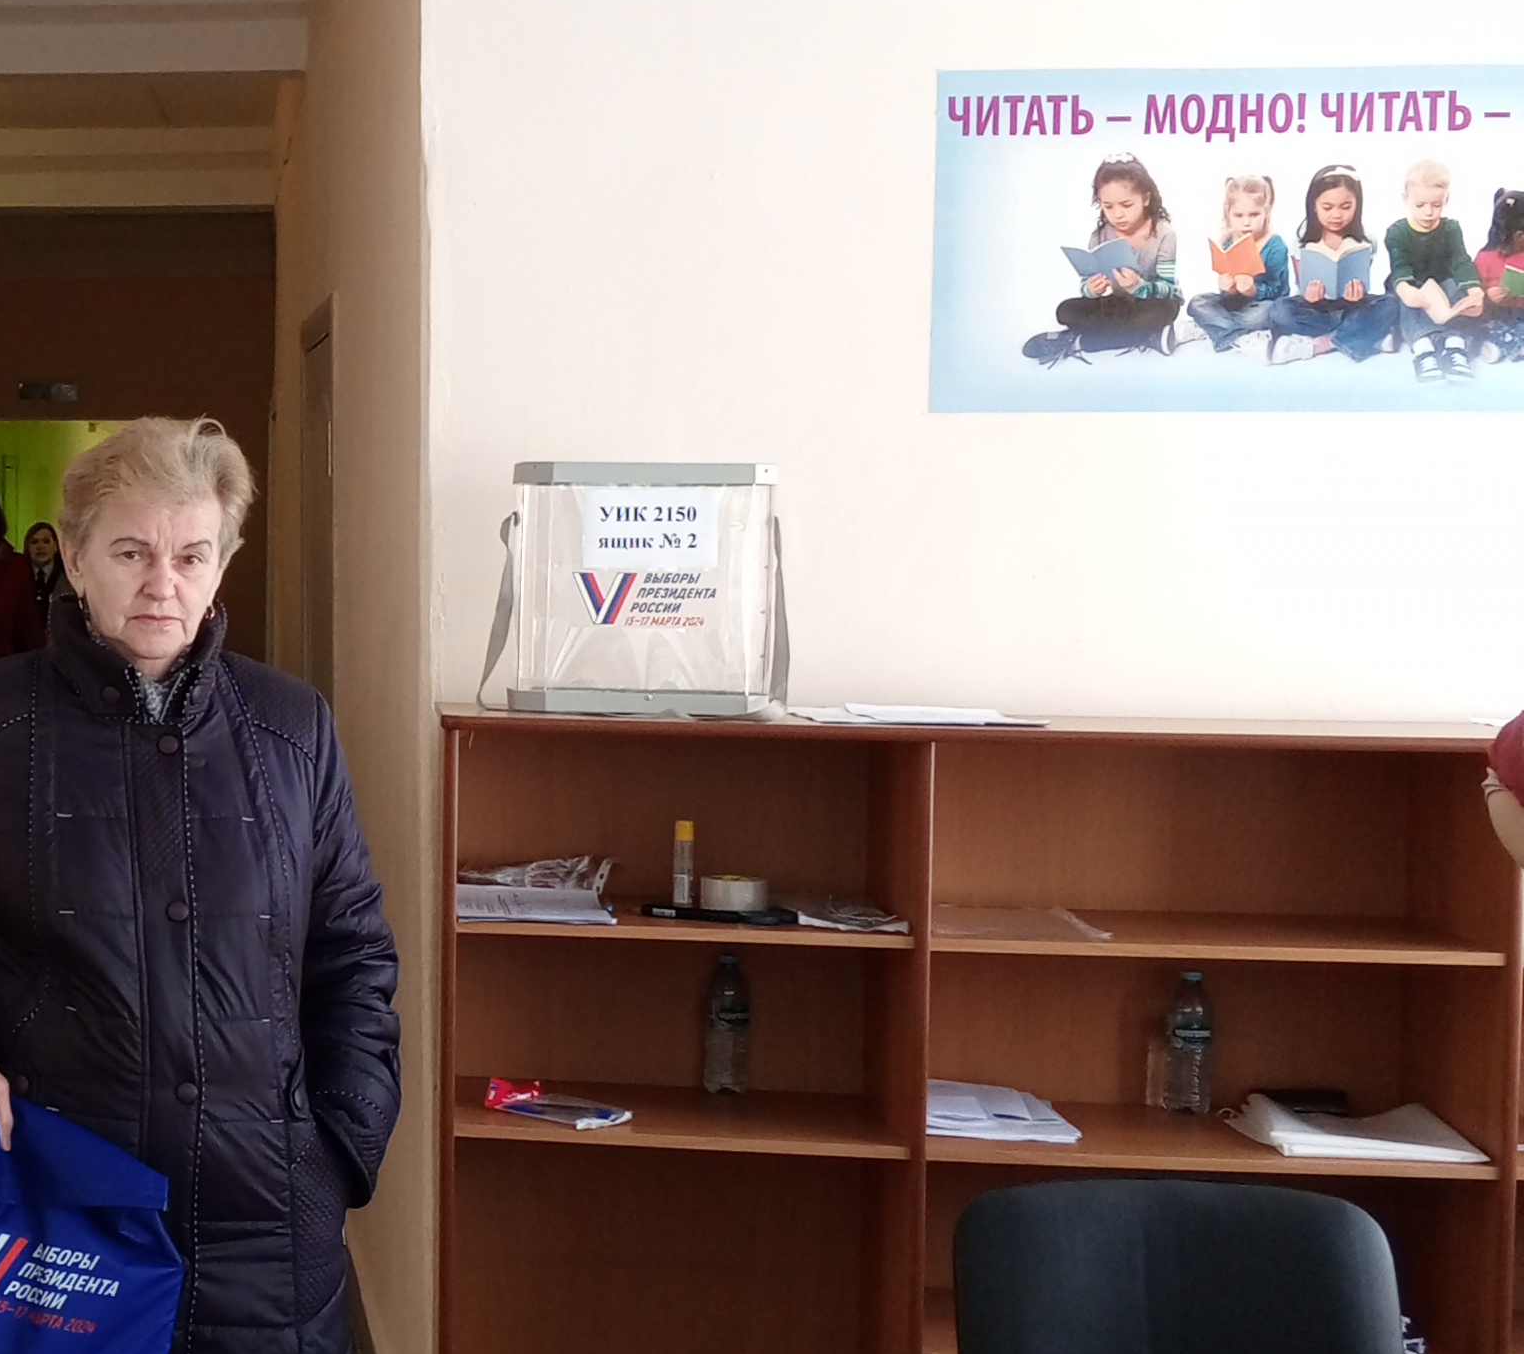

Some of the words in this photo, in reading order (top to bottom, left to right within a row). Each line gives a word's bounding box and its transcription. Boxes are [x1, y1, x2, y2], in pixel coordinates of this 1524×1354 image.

[947, 94, 1094, 136] ЧИТАТЬ
[1143, 92, 1307, 143] МОДНО!
[1320, 90, 1472, 133] ЧИТАТЬ
[599, 506, 648, 523] УИК
[653, 506, 697, 523] 2150
[598, 536, 654, 552] ящик
[658, 533, 683, 550] №
[687, 533, 698, 549] 2
[643, 573, 701, 585] ВЫБОРЫ
[636, 588, 717, 601] ПРЕЗИДЕНТА
[629, 602, 681, 614] РОССИИ
